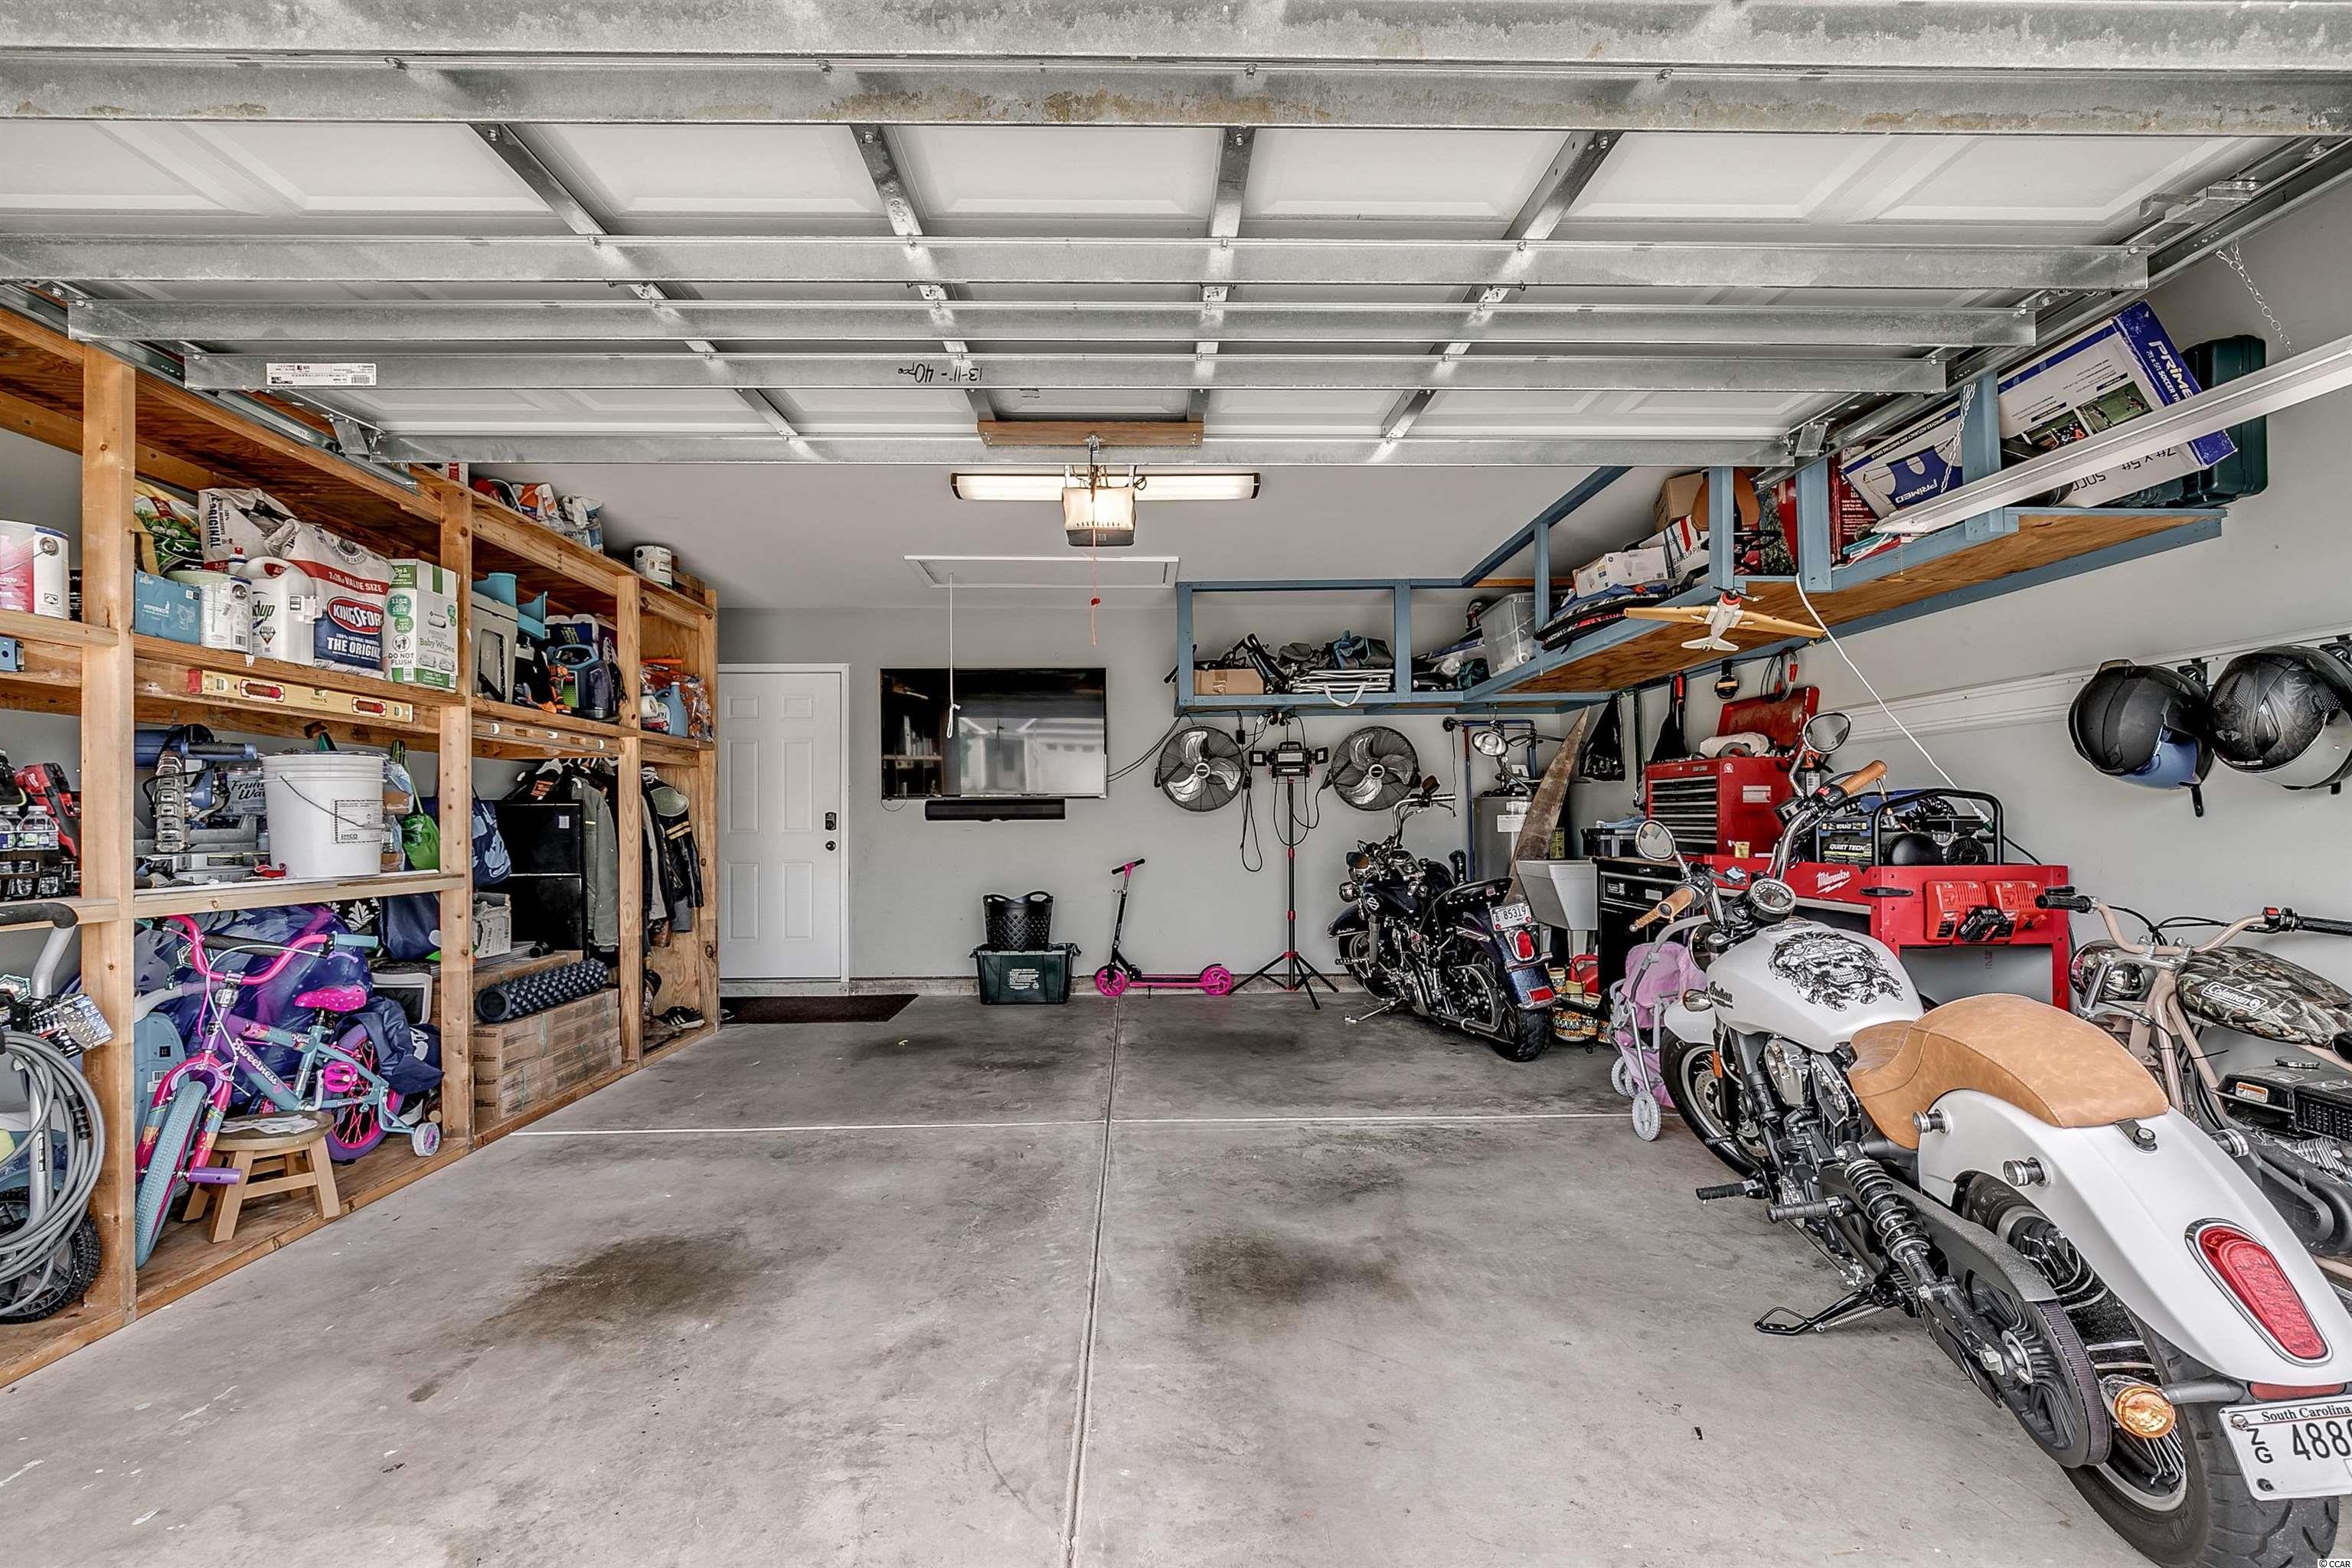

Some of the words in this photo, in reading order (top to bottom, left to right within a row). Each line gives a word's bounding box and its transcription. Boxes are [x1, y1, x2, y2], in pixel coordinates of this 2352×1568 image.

[2148, 341, 2194, 399] PRIME
[2158, 371, 2176, 394] SOCCER
[1895, 479, 1938, 503] PRIMED
[345, 577, 364, 590] VALUE
[365, 583, 383, 592] SIZE
[327, 637, 348, 652] THE
[420, 638, 436, 648] Baby
[436, 640, 455, 652] Wipes
[1503, 906, 1526, 920] 85319
[2208, 985, 2251, 1004] Coleman
[233, 1037, 279, 1086] Sweetness
[2261, 1410, 2297, 1423] South
[2301, 1406, 2351, 1419] Carolina
[2255, 1447, 2274, 1464] G
